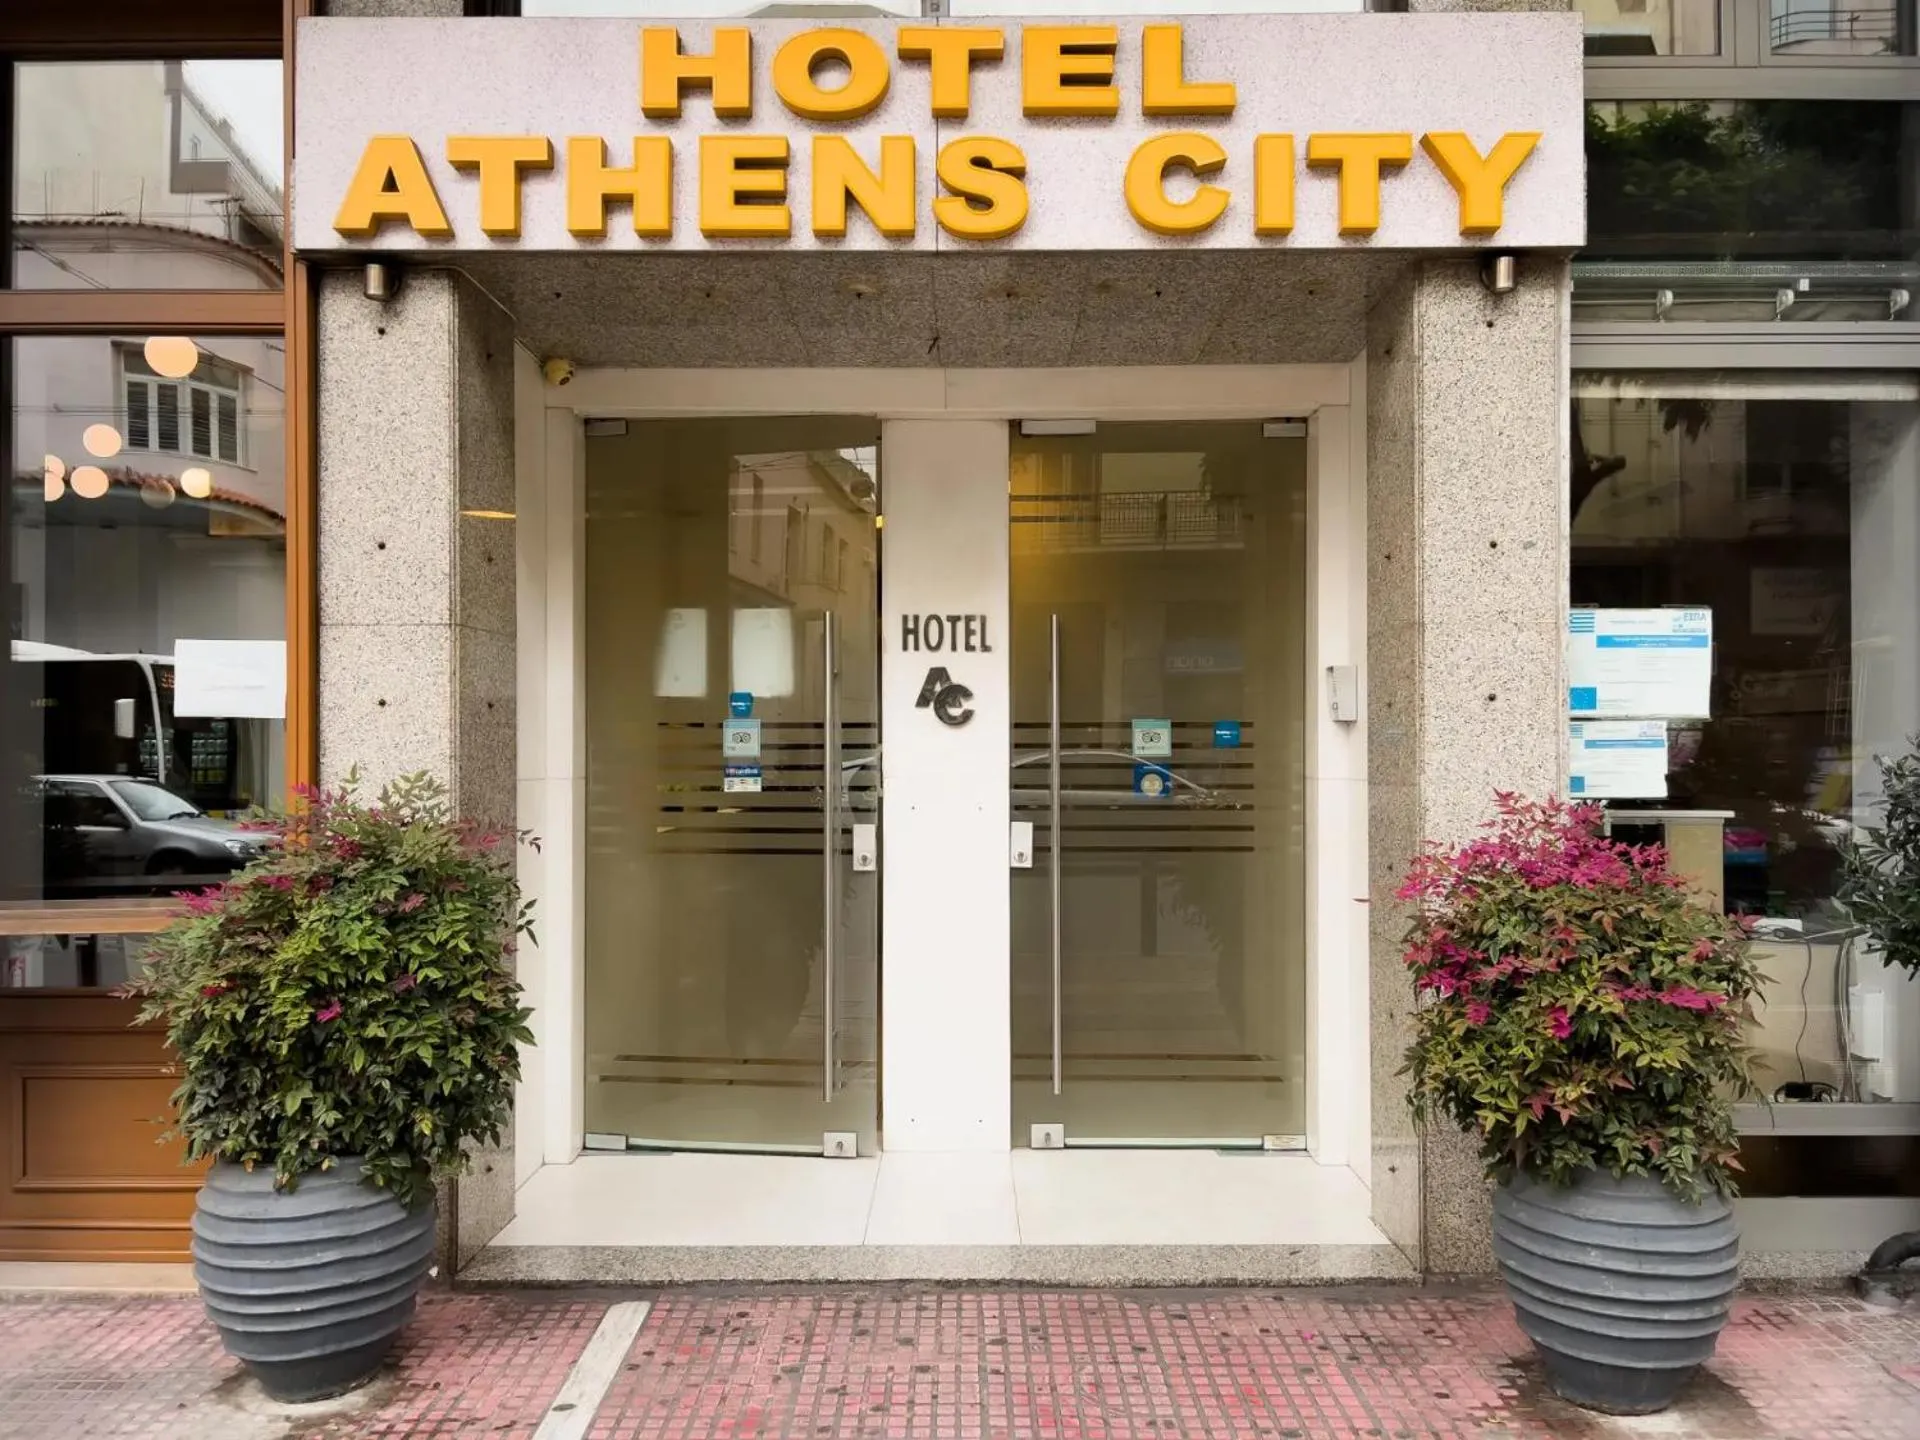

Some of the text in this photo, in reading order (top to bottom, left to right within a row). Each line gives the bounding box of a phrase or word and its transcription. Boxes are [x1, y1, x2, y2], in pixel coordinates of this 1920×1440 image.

[640, 24, 1236, 121] HOTEL
[333, 130, 1543, 240] ATHENS CITY
[902, 614, 992, 652] HOTEL
